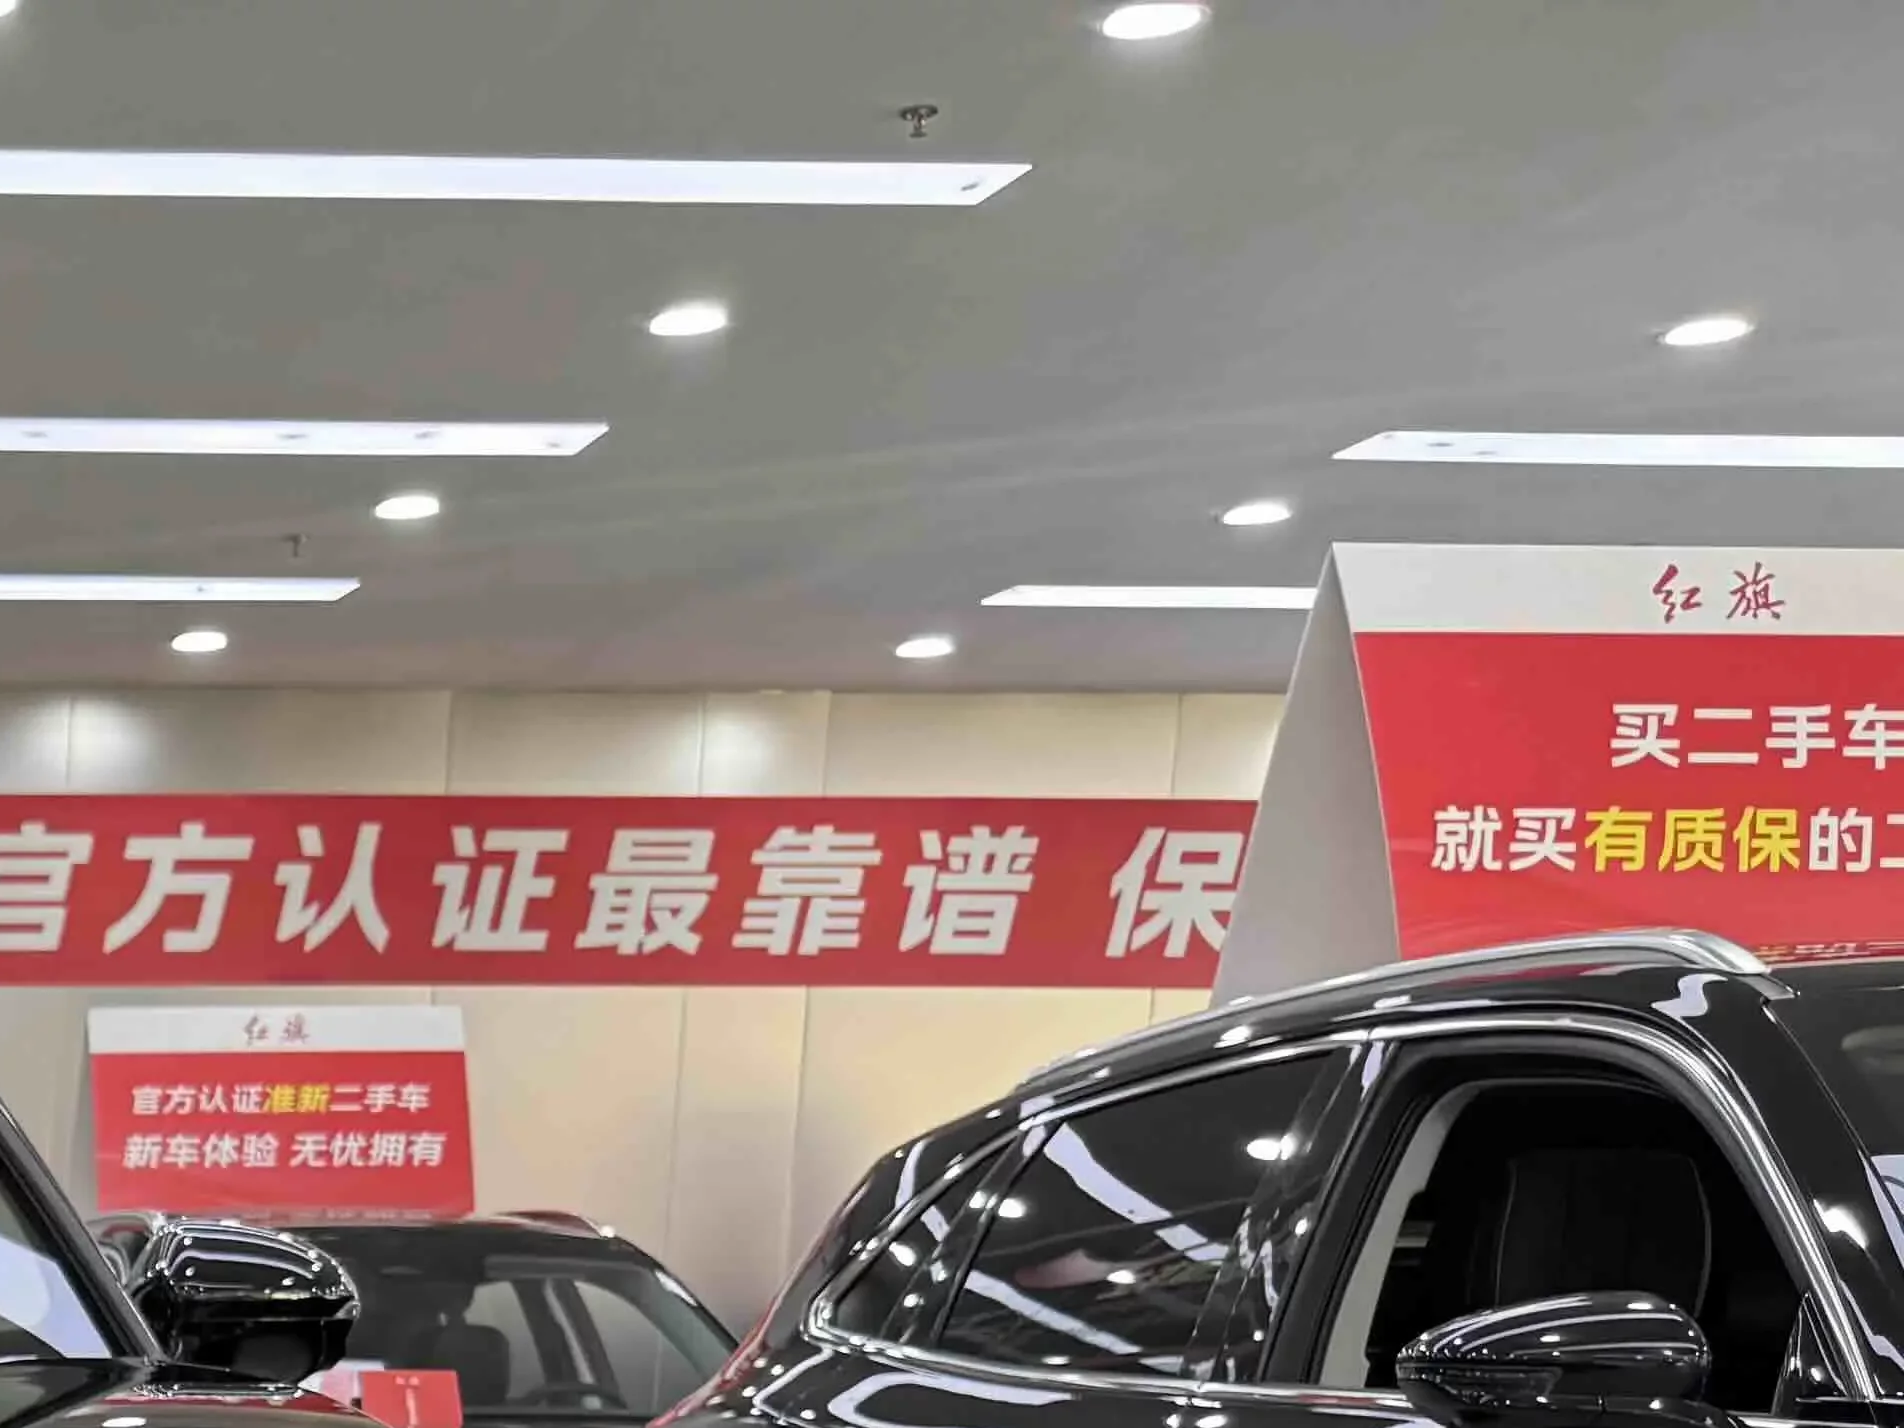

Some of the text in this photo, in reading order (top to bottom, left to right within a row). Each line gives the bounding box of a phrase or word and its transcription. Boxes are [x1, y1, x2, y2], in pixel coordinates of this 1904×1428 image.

[1652, 561, 1786, 623] 红旗
[1609, 703, 1904, 770] 买二手车
[1105, 826, 1247, 959] 保
[131, 1083, 431, 1116] 官方认证准新二手车
[122, 1130, 447, 1170] 新车体验 无忧拥有
